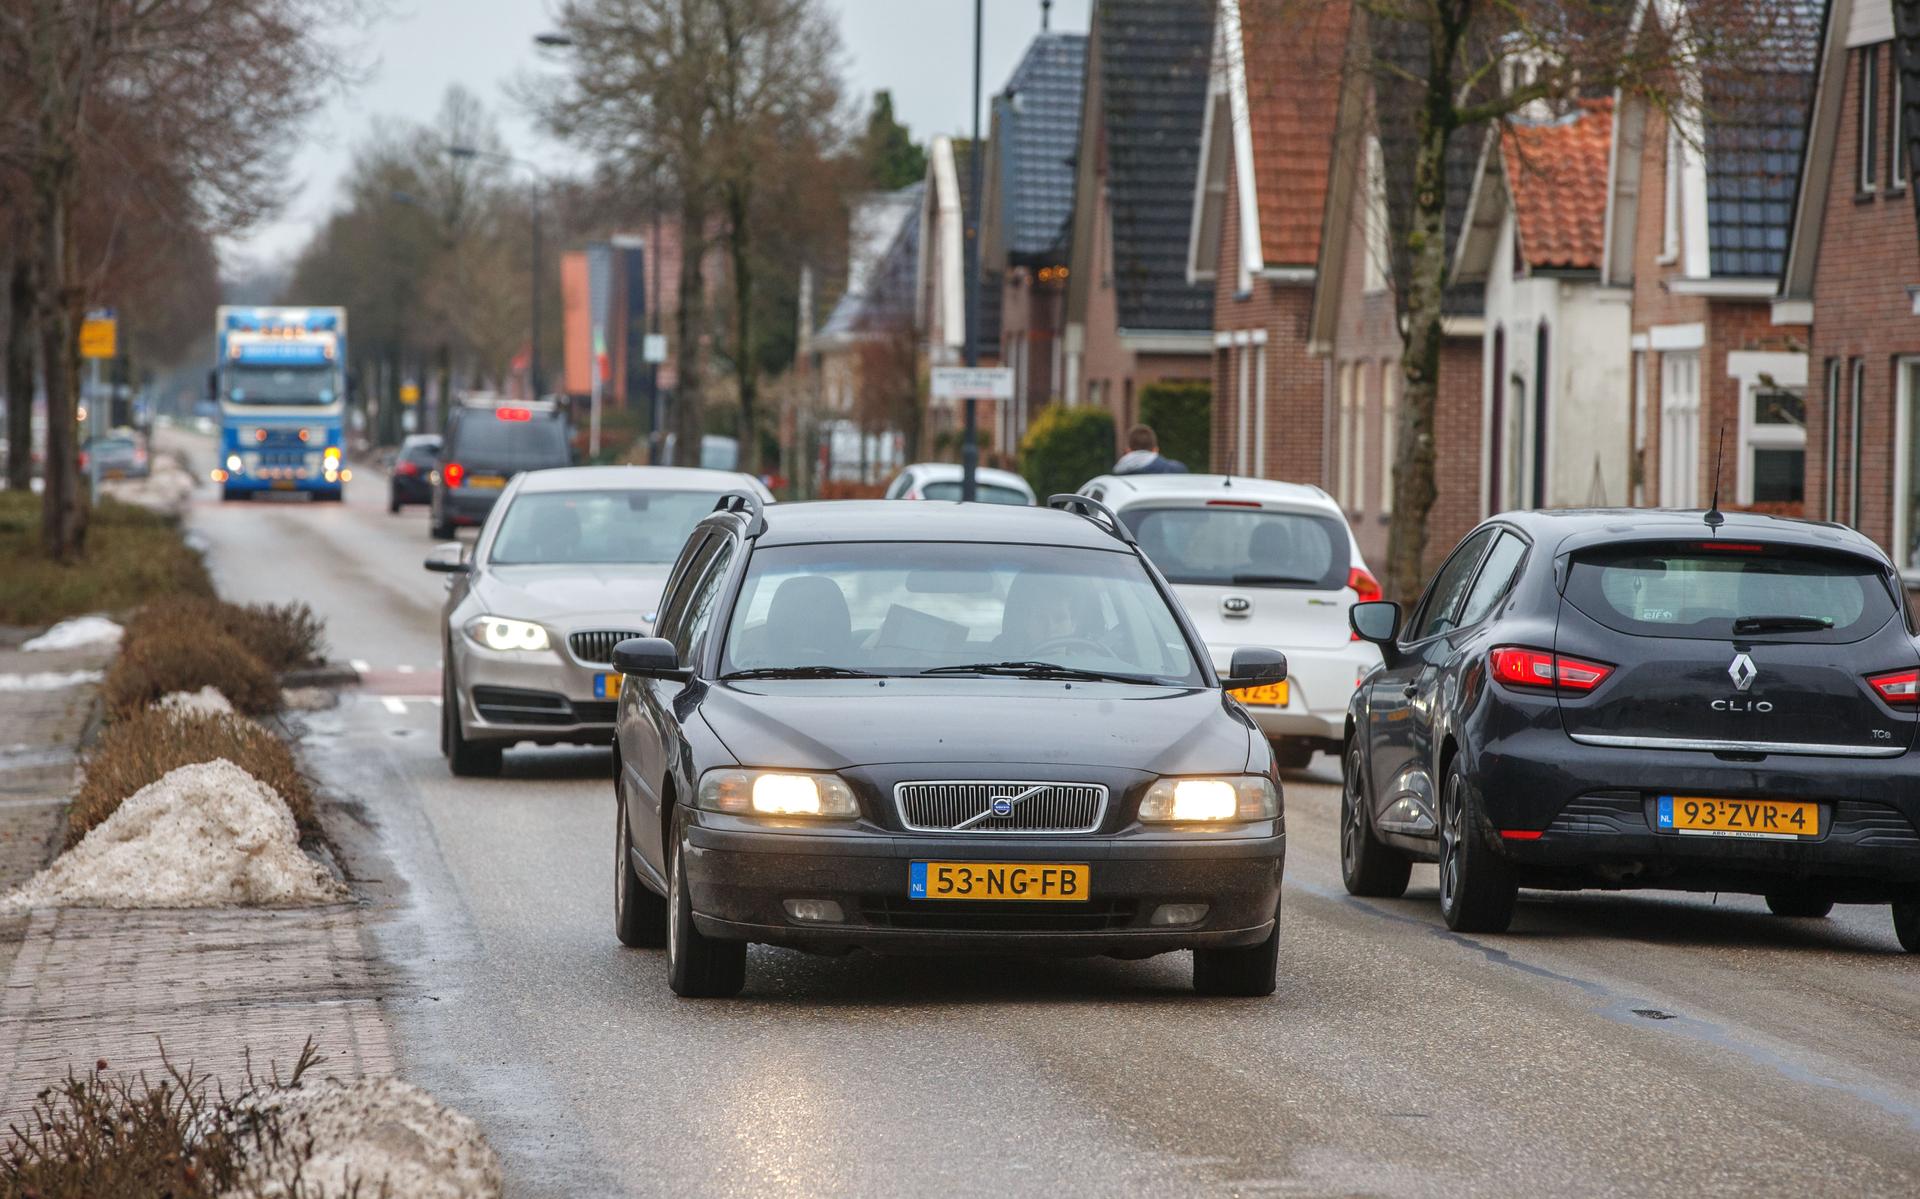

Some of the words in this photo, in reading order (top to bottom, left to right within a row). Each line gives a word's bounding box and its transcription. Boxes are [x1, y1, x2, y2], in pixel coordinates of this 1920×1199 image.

[1710, 700, 1773, 712] CLIO
[1872, 729, 1891, 739] TCe
[1660, 815, 1672, 823] NL
[937, 867, 1077, 895] 53-NG-FB
[912, 883, 925, 892] NL
